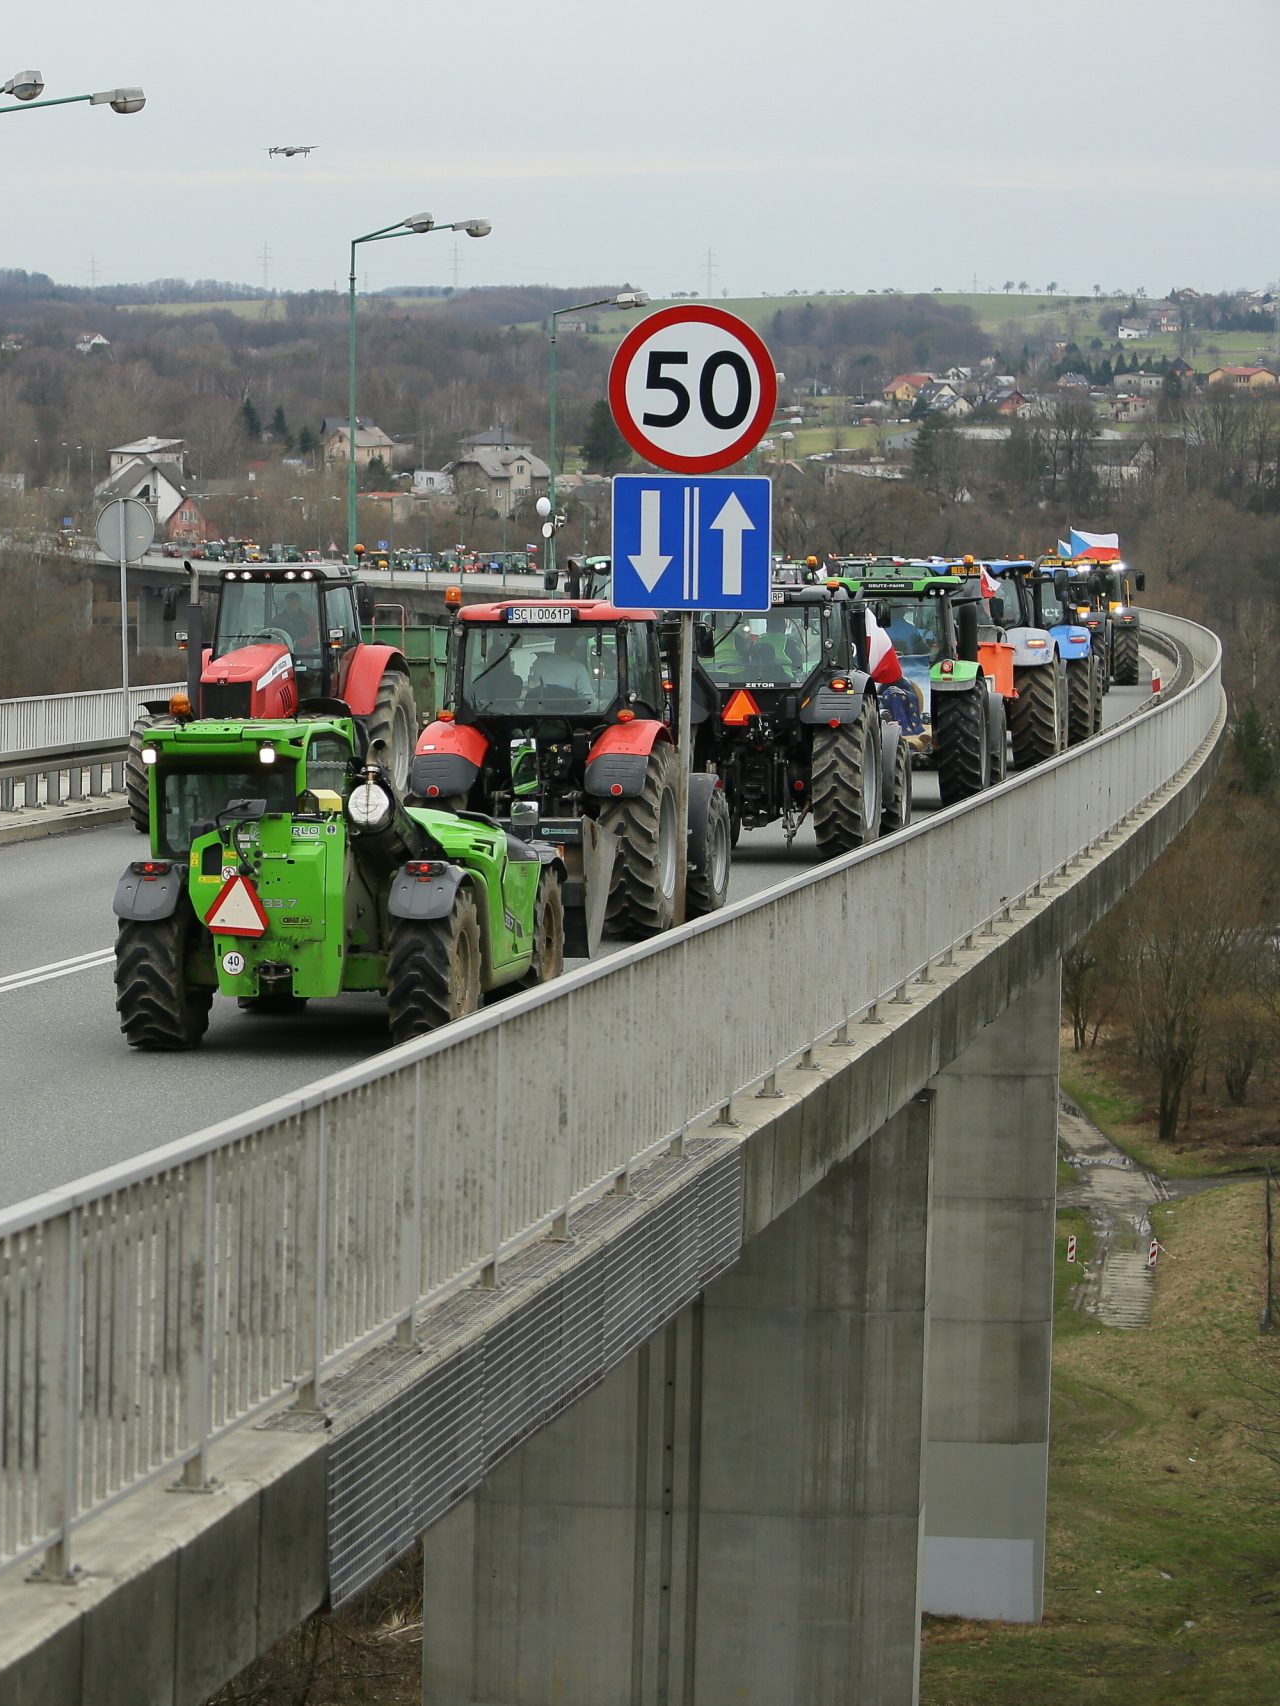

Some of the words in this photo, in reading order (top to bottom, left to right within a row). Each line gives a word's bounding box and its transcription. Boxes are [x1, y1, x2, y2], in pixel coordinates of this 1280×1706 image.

[642, 350, 752, 430] 50
[772, 592, 783, 602] 8P
[514, 608, 533, 620] SCI
[537, 608, 570, 620] 0061P
[291, 826, 320, 837] RLO
[260, 898, 298, 909] 33.7
[227, 955, 240, 967] 40
